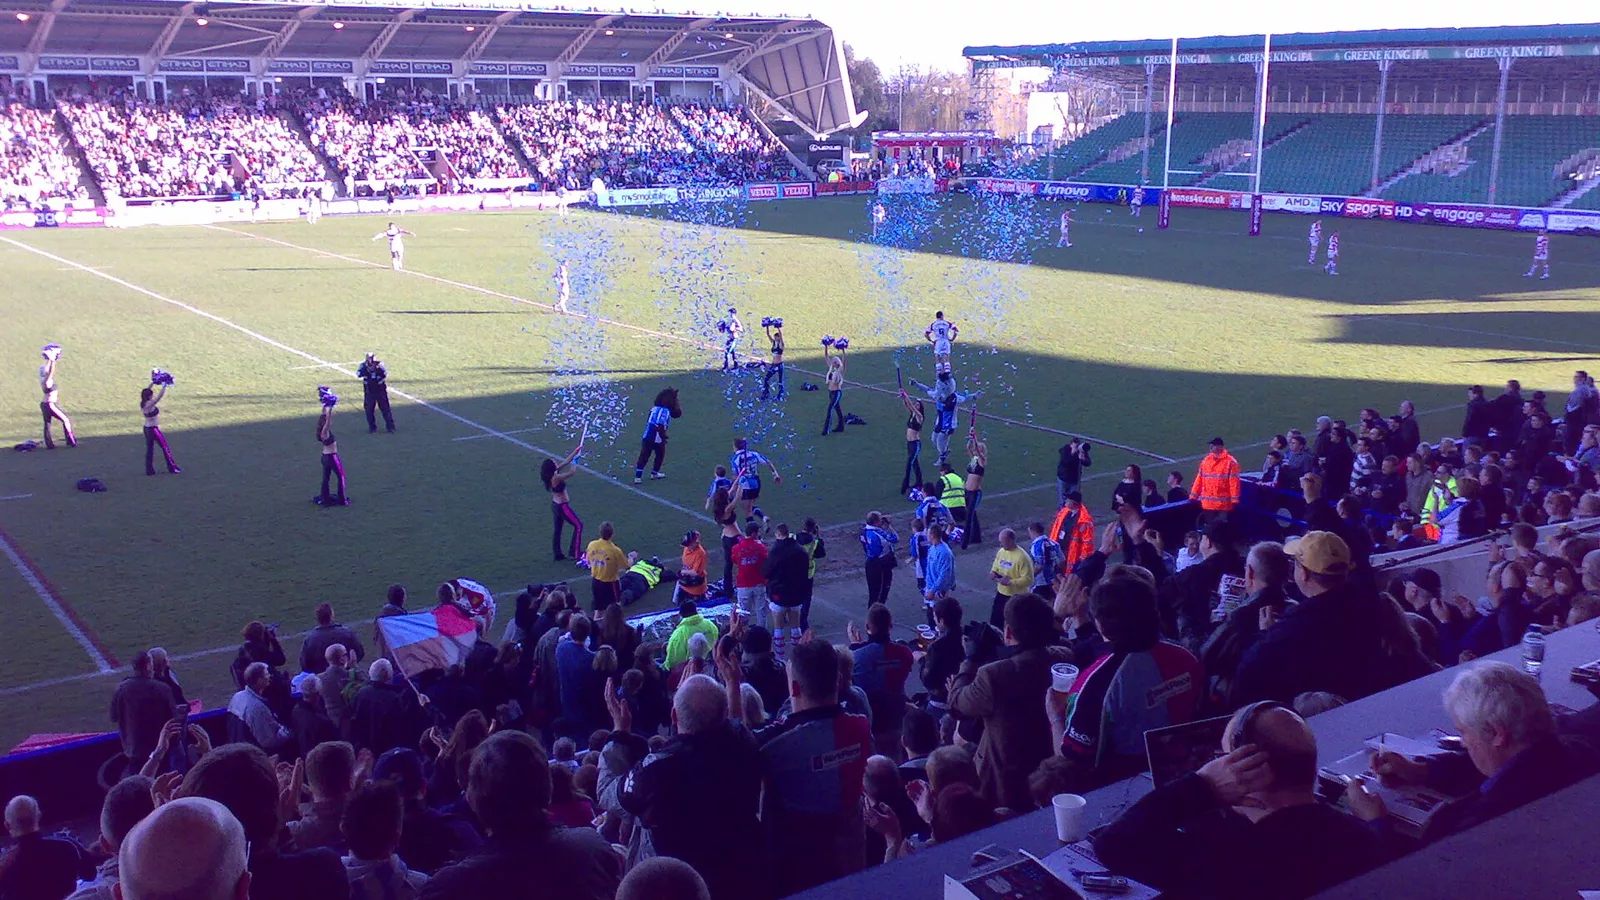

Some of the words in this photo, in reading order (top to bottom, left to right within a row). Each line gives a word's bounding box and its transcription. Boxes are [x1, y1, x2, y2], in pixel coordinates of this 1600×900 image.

[1273, 52, 1297, 61] KING
[1344, 49, 1382, 60] GREENE
[1384, 48, 1410, 59] KING
[1465, 47, 1509, 58] GREENE
[1512, 46, 1542, 57] KING
[1089, 57, 1107, 65] KING
[1143, 55, 1172, 64] GREEN
[1177, 55, 1197, 63] KING
[784, 186, 810, 196] VELUX
[1170, 192, 1226, 205] hones4u.co.uk
[1285, 197, 1311, 207] AMD
[1321, 201, 1345, 212] SKY
[1346, 203, 1393, 216] SPORTS
[1395, 206, 1413, 217] HD
[1433, 208, 1484, 223] engage
